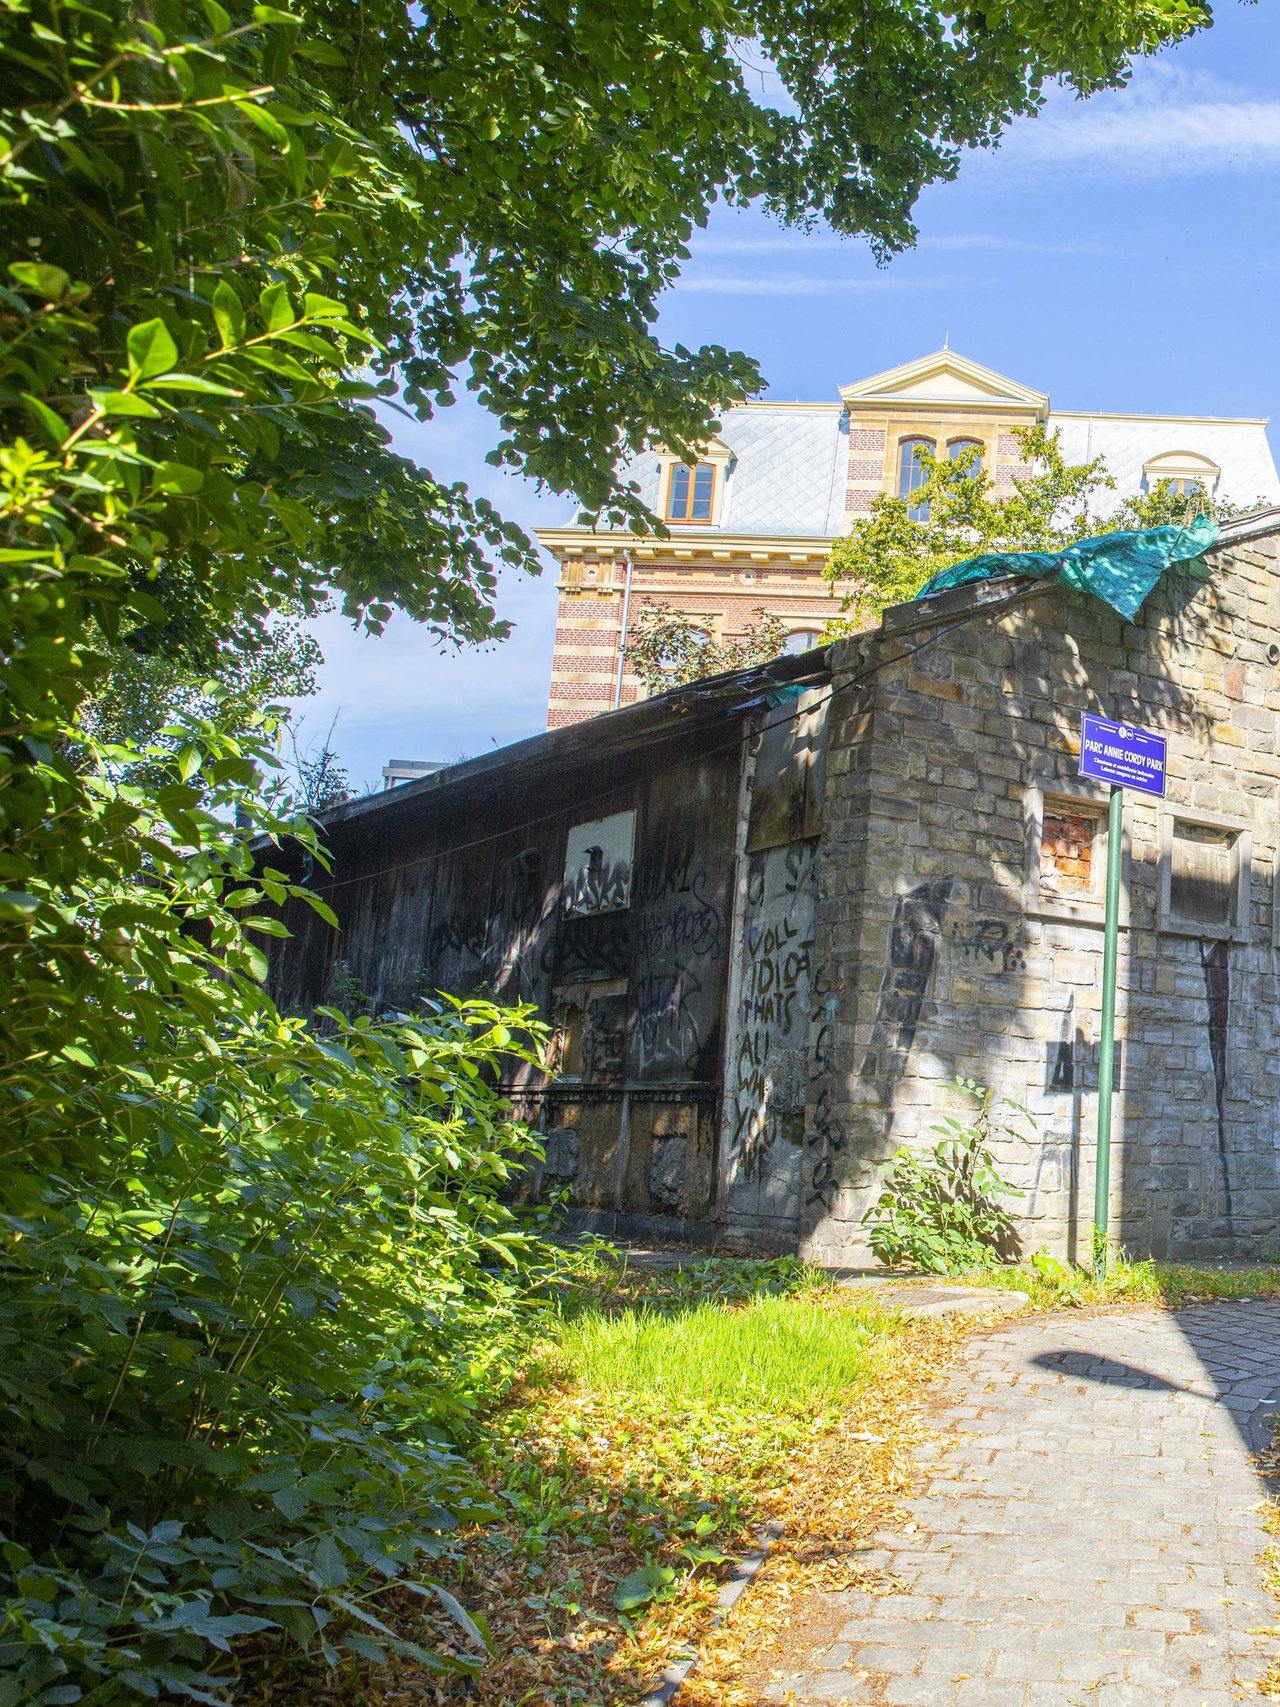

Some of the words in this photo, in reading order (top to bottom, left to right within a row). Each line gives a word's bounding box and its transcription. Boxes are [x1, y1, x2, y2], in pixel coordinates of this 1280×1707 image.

[1085, 739, 1103, 755] PARC
[1104, 745, 1124, 760] ANNIE
[1124, 751, 1146, 766] CORDY
[1147, 757, 1164, 771] PARK
